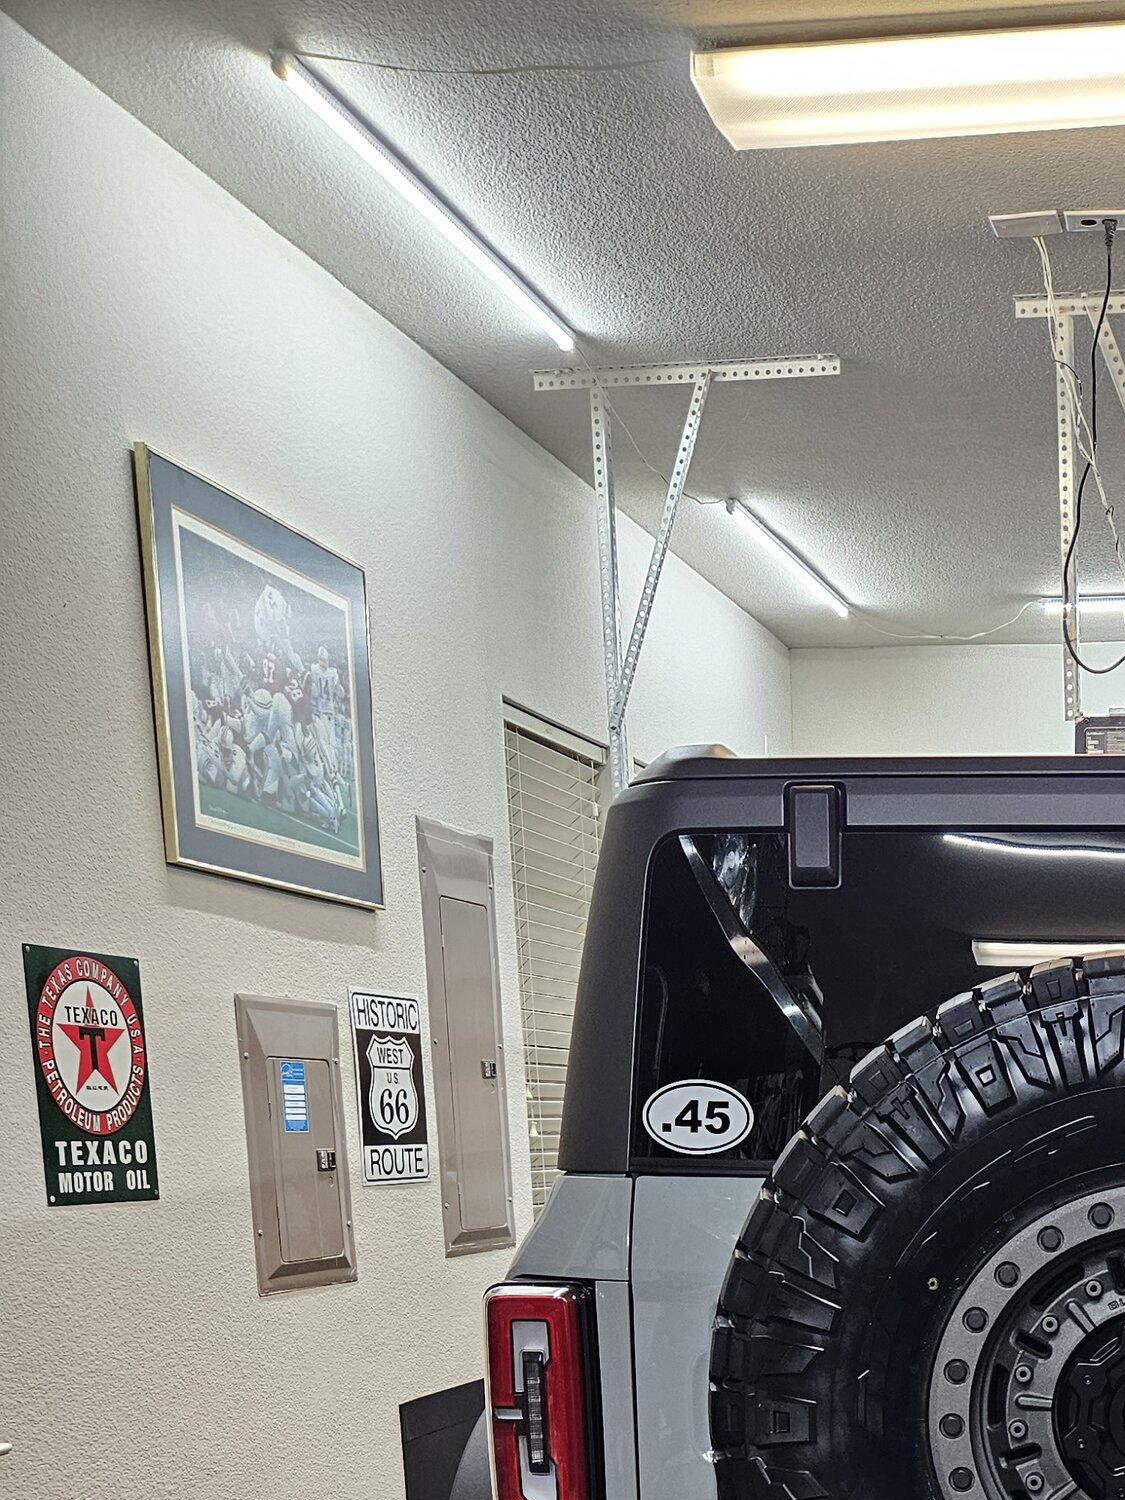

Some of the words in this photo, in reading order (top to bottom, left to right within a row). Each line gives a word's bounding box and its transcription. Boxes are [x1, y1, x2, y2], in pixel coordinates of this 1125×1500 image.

[42, 963, 73, 1009] TEXAS
[75, 959, 130, 1007] COMPANY
[38, 1013, 51, 1049] THE
[64, 1005, 118, 1027] TEXACO
[355, 997, 418, 1031] HISTORIC
[376, 1046, 404, 1065] WEST
[42, 1059, 101, 1132] PETROLEUM
[105, 1064, 144, 1131] PRODUCTS
[379, 1088, 410, 1125] 66
[662, 1099, 731, 1135] .45
[54, 1139, 148, 1167] TEXACO
[370, 1147, 425, 1176] ROUTE
[57, 1170, 114, 1194] MOTOR
[126, 1169, 151, 1191] OIL
